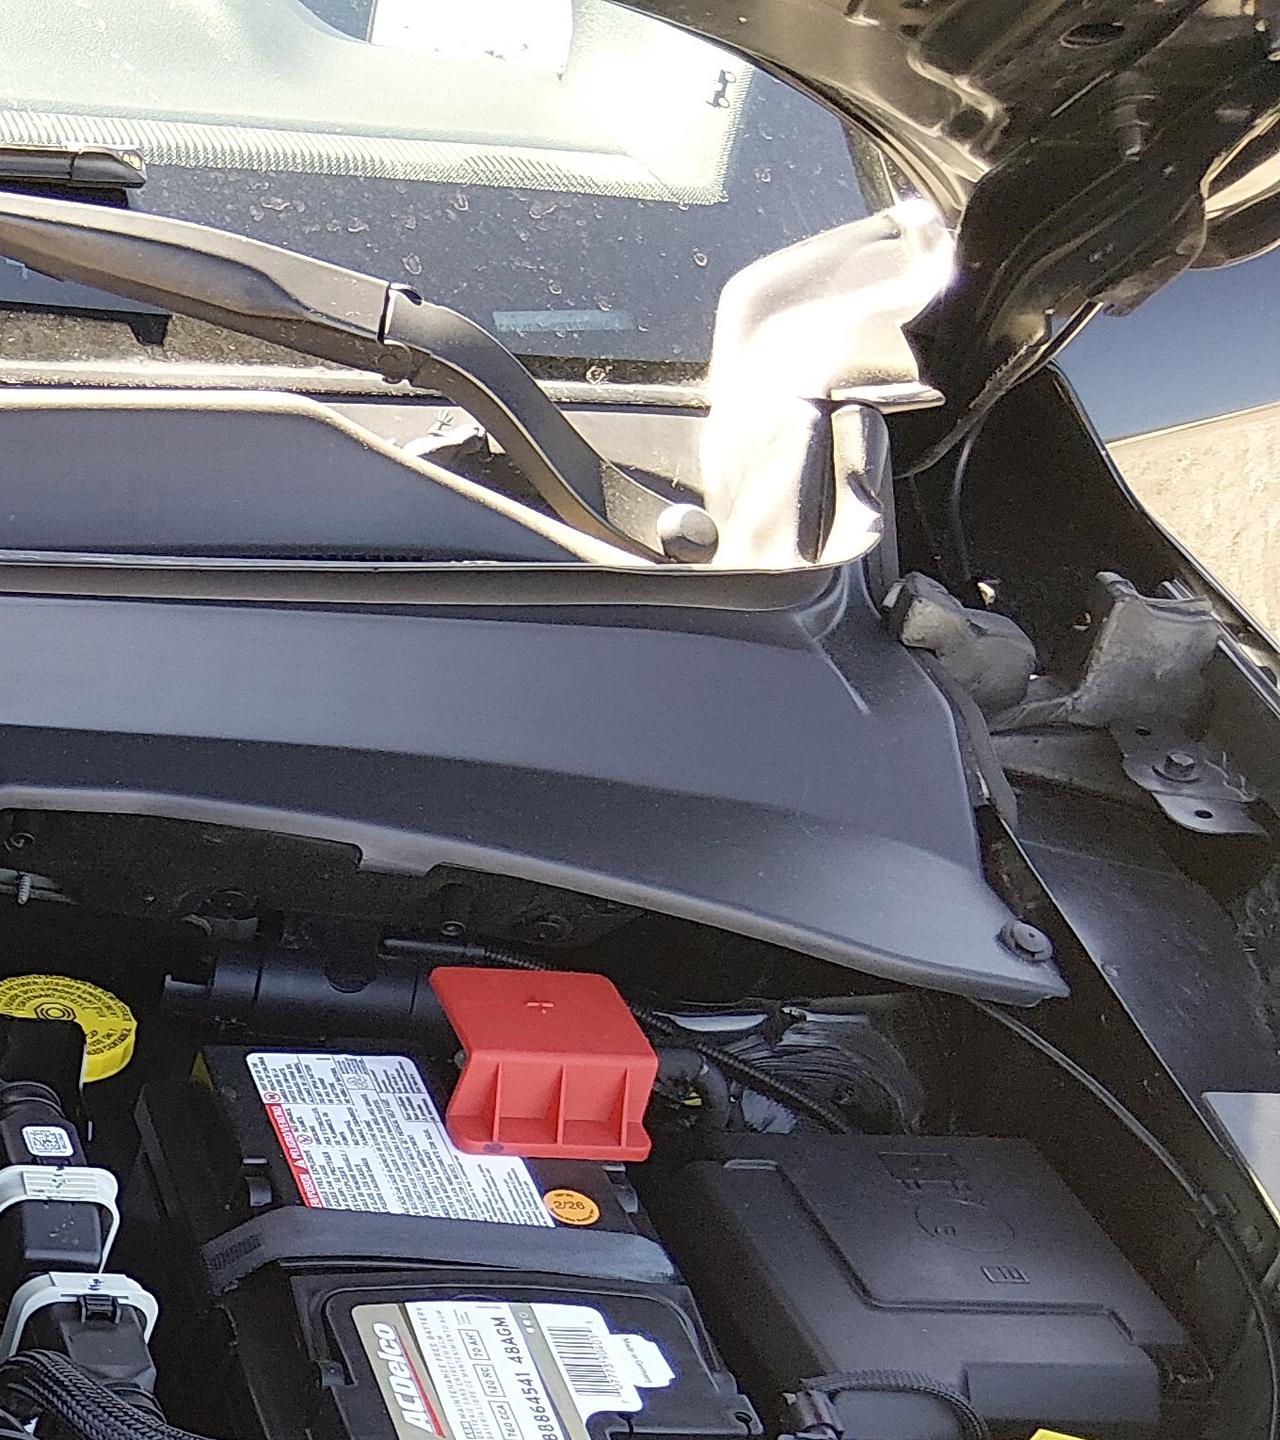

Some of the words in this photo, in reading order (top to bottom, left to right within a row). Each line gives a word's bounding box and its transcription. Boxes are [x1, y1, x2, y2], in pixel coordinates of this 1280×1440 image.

[414, 1306, 435, 1340] BATTERY
[493, 1316, 524, 1365] 48AGM
[372, 1321, 434, 1433] ACDelco
[437, 1364, 467, 1419] MAINTENANCE
[493, 1403, 510, 1420] CCA
